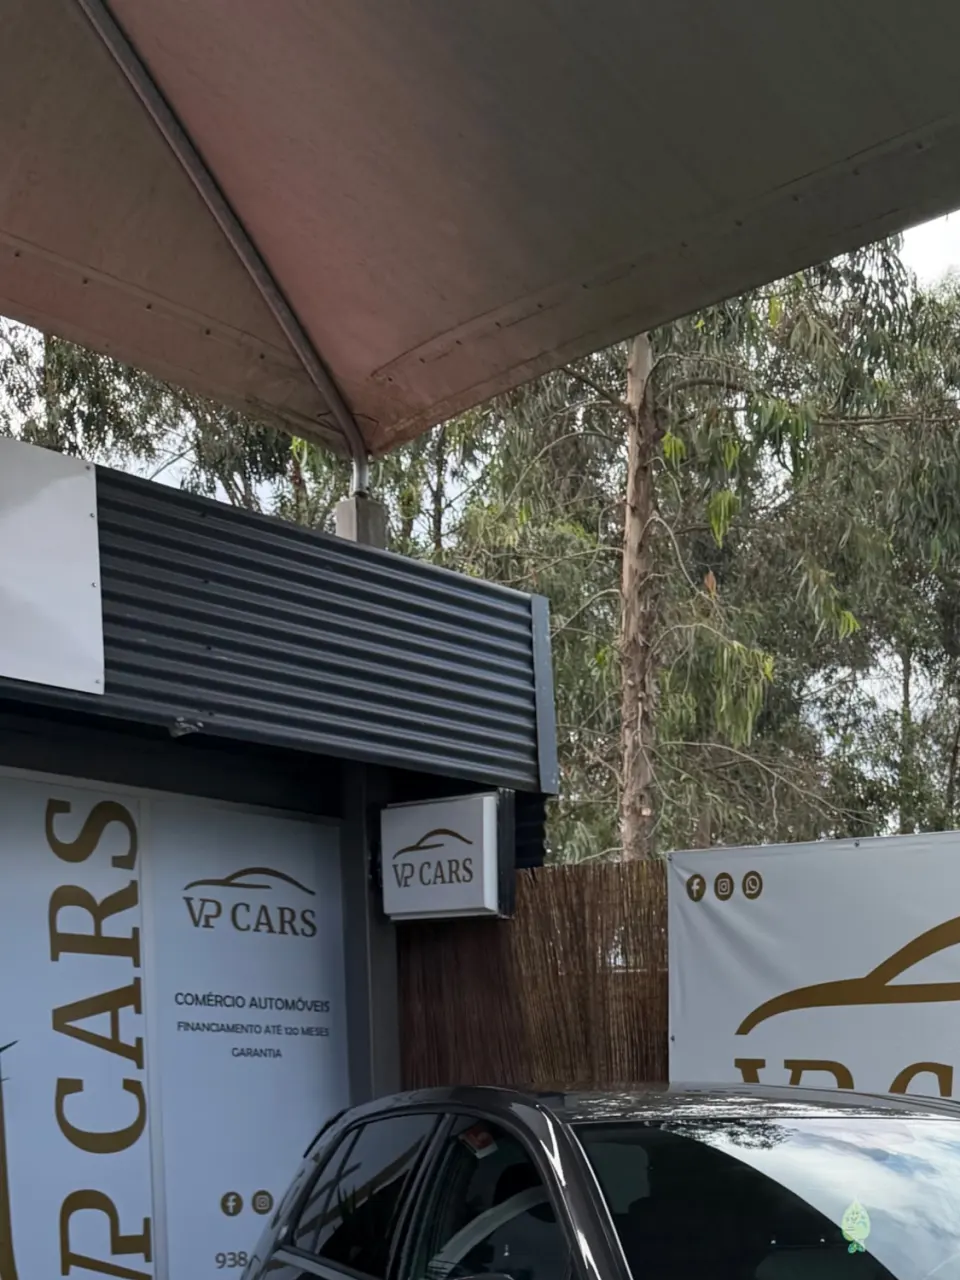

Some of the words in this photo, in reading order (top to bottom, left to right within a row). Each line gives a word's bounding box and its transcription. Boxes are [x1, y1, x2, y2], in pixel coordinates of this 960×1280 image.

[392, 862, 415, 889] VP
[419, 857, 474, 886] CARS
[183, 896, 222, 929] VP
[231, 902, 318, 938] CARS
[45, 797, 148, 1155] CARS
[174, 991, 246, 1009] COMÉRCIO
[249, 997, 331, 1013] AUTOMÓVEIS
[176, 1021, 262, 1035] FINANCIAMENTO
[263, 1023, 283, 1036] ATÉ
[301, 1026, 330, 1037] MESES
